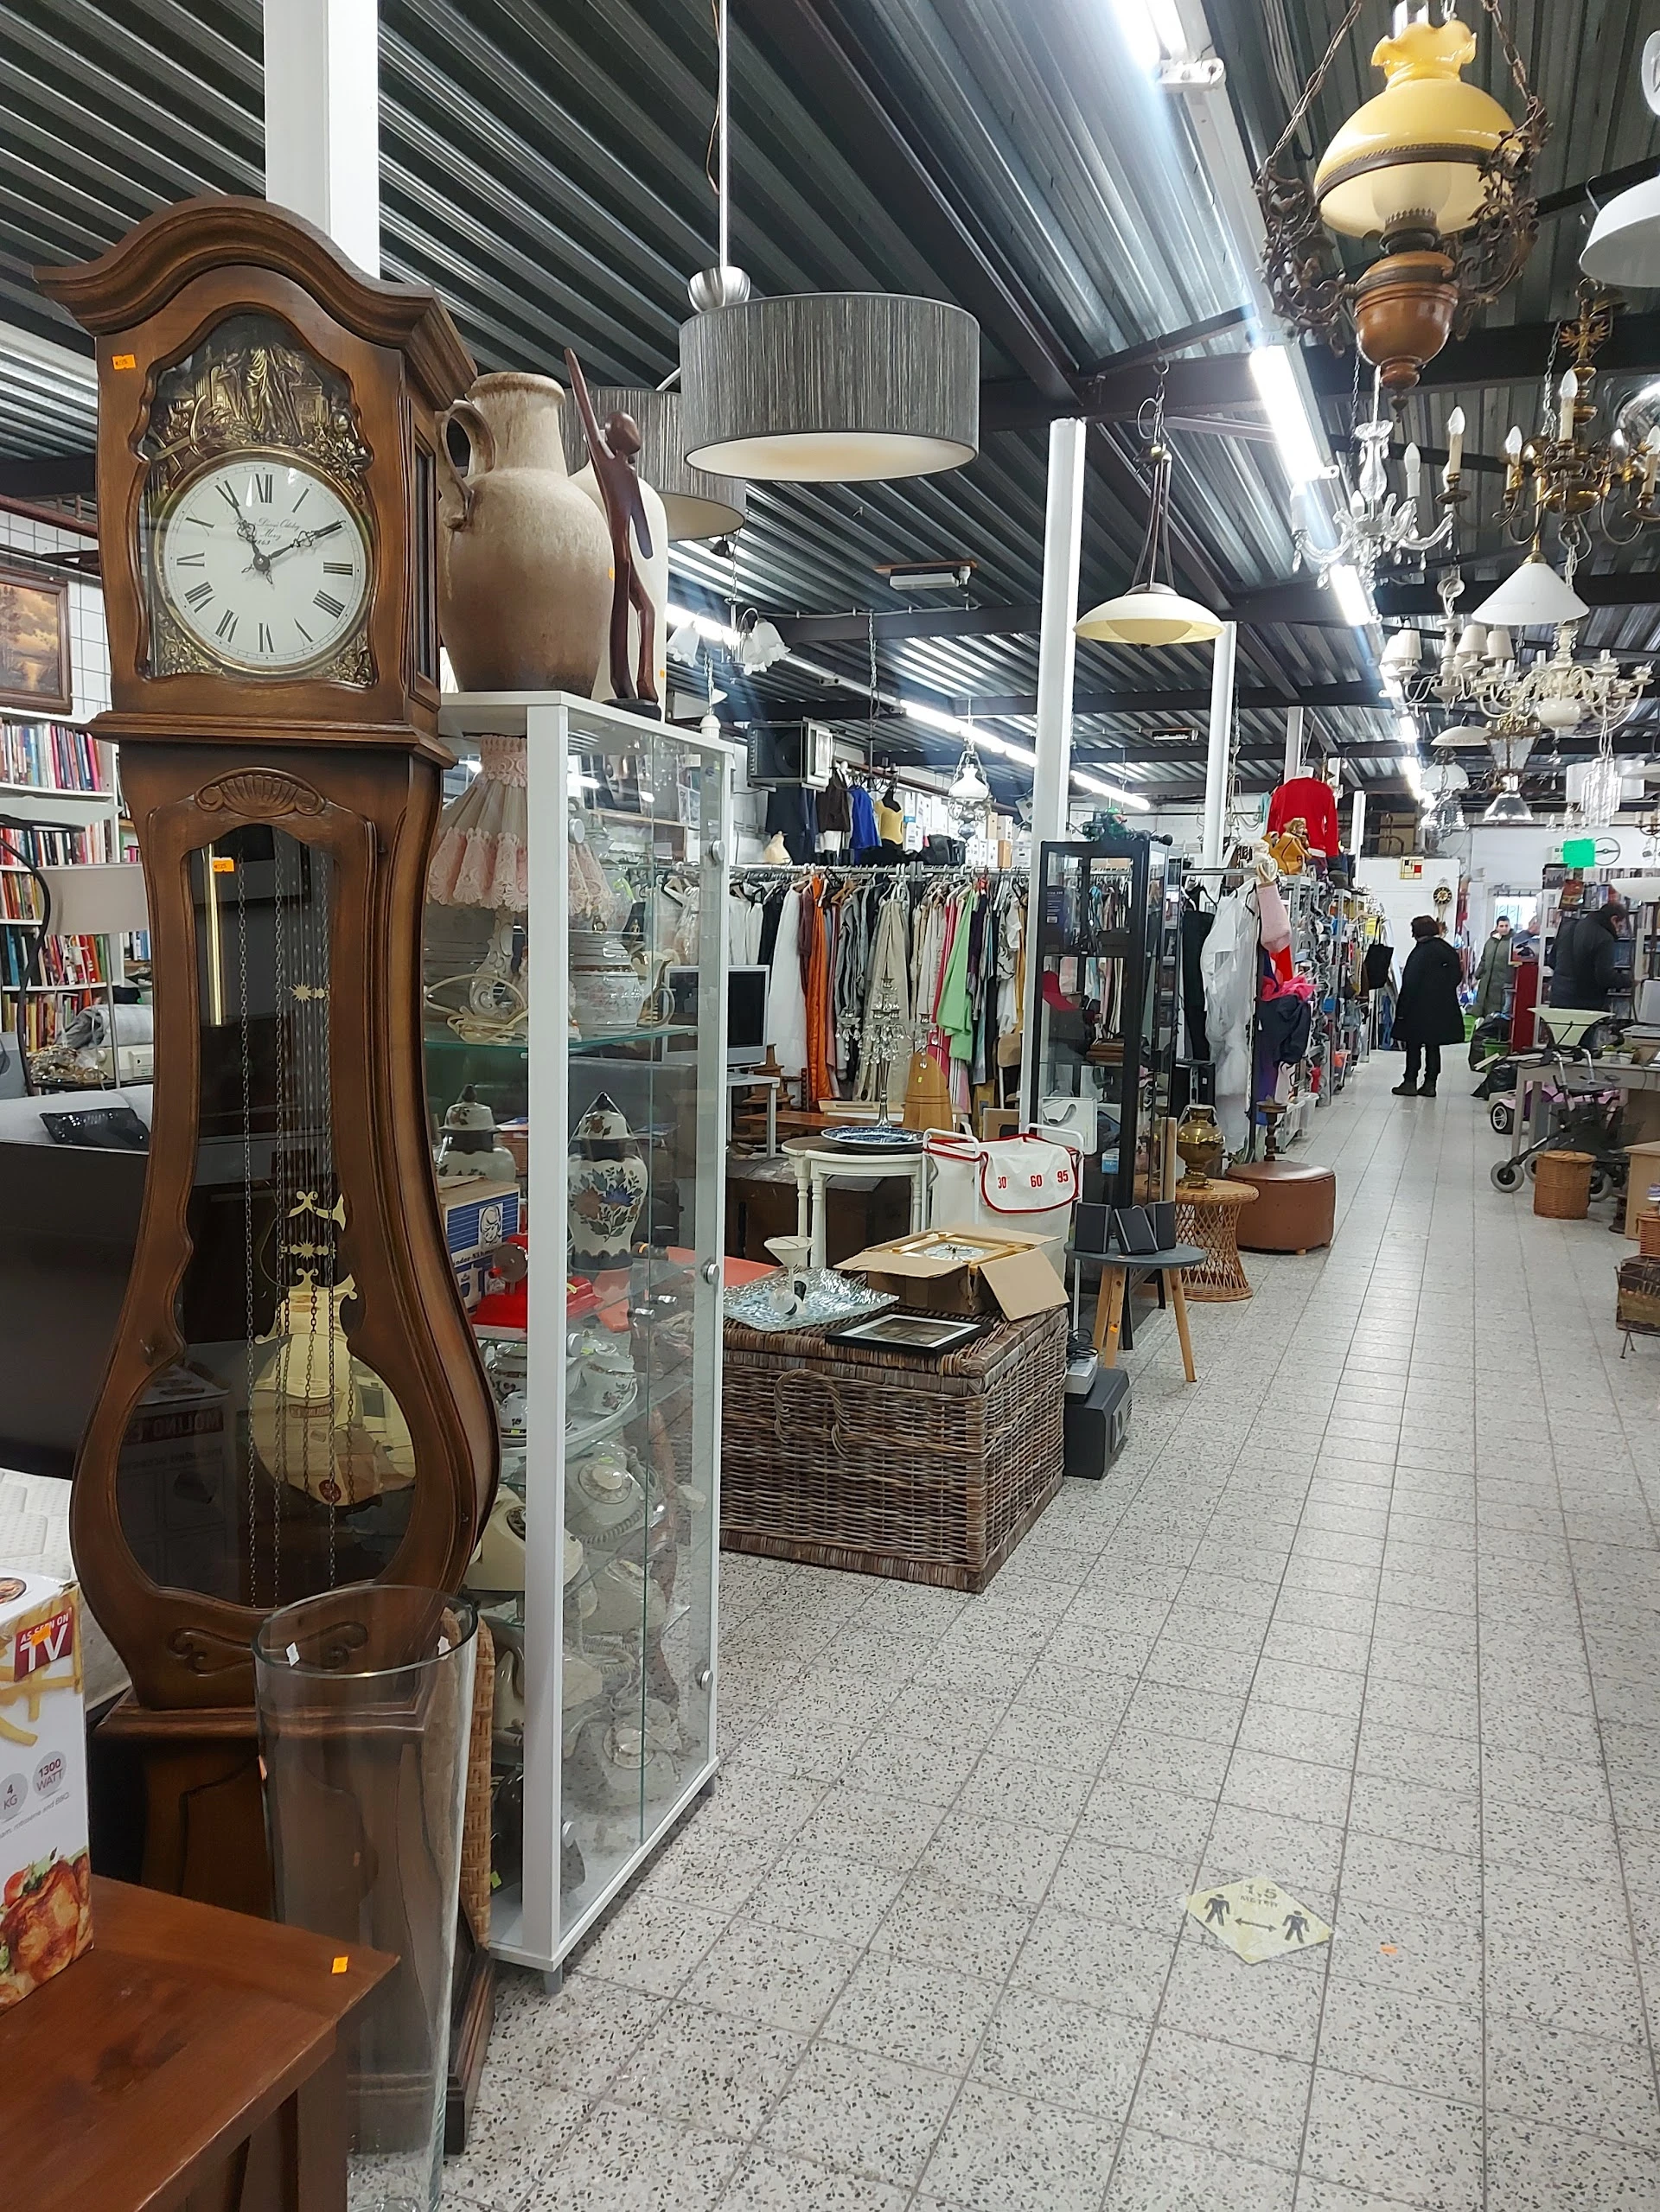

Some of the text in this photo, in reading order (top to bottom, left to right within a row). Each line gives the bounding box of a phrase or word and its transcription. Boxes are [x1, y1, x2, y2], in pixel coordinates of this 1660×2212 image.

[322, 562, 353, 576] III
[998, 1170, 1069, 1189] 30 60 95
[20, 1630, 32, 1644] AS
[56, 1612, 69, 1627] ON
[19, 1622, 68, 1673] TV
[38, 1758, 61, 1778] 1300
[7, 1784, 14, 1795] 4
[36, 1768, 64, 1792] WATT
[3, 1794, 18, 1811] KG
[1245, 1884, 1277, 1899] 1,5
